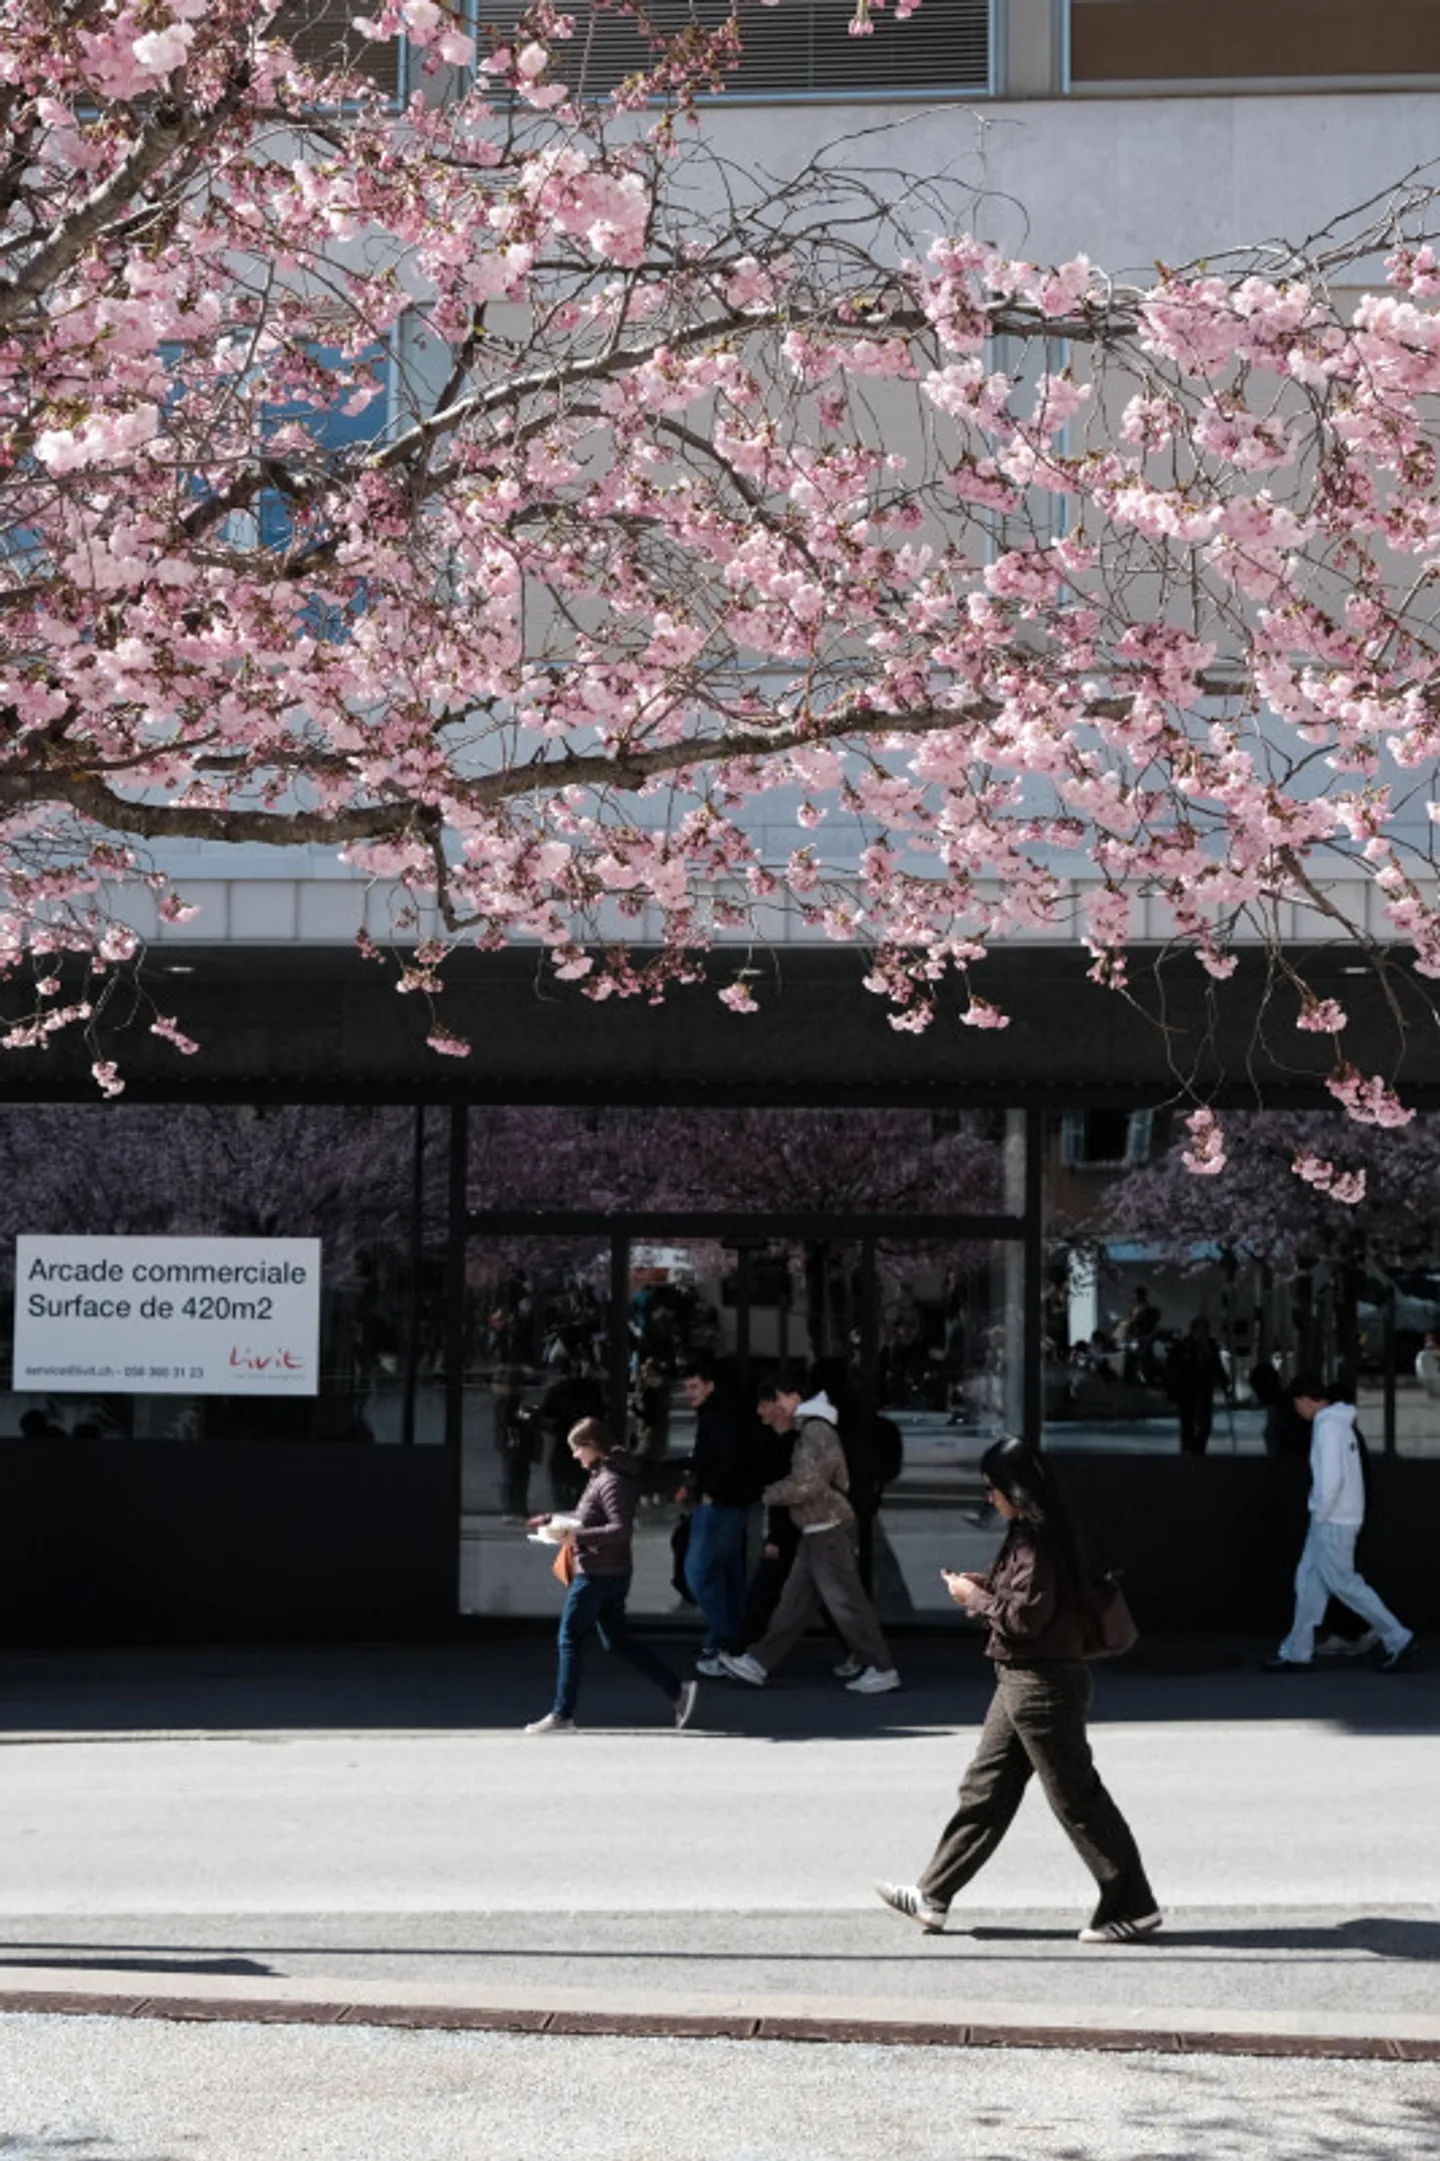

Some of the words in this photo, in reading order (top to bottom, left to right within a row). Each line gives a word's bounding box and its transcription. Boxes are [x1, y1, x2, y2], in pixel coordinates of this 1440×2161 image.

[28, 1258, 124, 1282] Arcade
[132, 1261, 307, 1285] commerciale
[28, 1294, 131, 1318] Surface
[140, 1296, 174, 1319] de
[181, 1297, 273, 1320] 420m2
[229, 1345, 305, 1369] Livit
